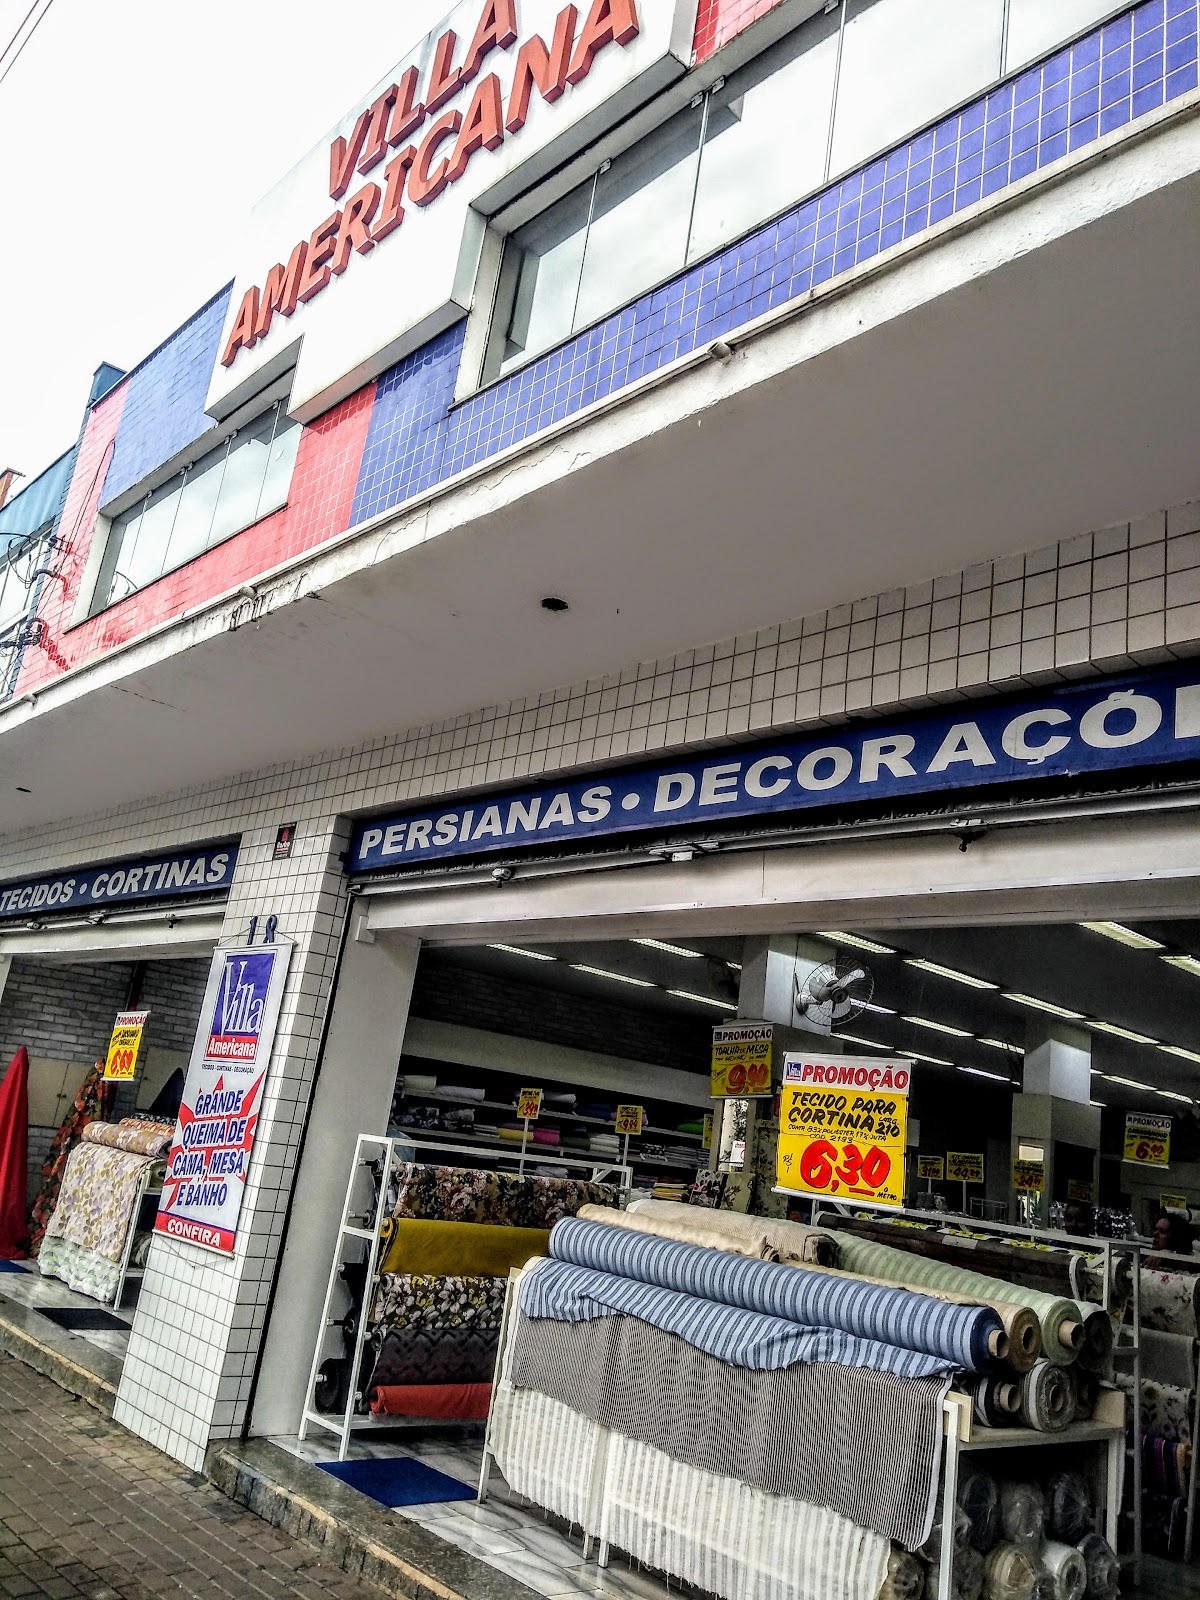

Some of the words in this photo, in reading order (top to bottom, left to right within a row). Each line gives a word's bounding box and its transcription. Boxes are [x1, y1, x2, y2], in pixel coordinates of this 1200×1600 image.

[329, 0, 517, 200] VILLA
[221, 0, 640, 367] AMERICANA
[358, 785, 612, 859] PERSIANAS
[0, 879, 76, 912] TECIDOS
[91, 853, 229, 899] CORTINAS
[221, 961, 264, 1038] Villa
[208, 1038, 255, 1057] Americana
[723, 1027, 772, 1042] PROMOÇÃO
[801, 1065, 909, 1091] PROMOÇÃO
[195, 1090, 244, 1116] GRANDE
[791, 1092, 848, 1111] TECIDO
[851, 1097, 897, 1116] PARA
[788, 1107, 875, 1133] CORTINA
[1132, 1117, 1171, 1129] PROMOÇÃO
[182, 1121, 225, 1150] QUEIMA
[227, 1119, 247, 1142] DE
[173, 1153, 207, 1180] CAMA,
[209, 1151, 244, 1174] MESA
[800, 1139, 891, 1193] 6,30
[176, 1184, 186, 1206] E
[184, 1183, 228, 1206] BANHO
[876, 1192, 898, 1201] METRO
[167, 1218, 221, 1247] CONFIRA
